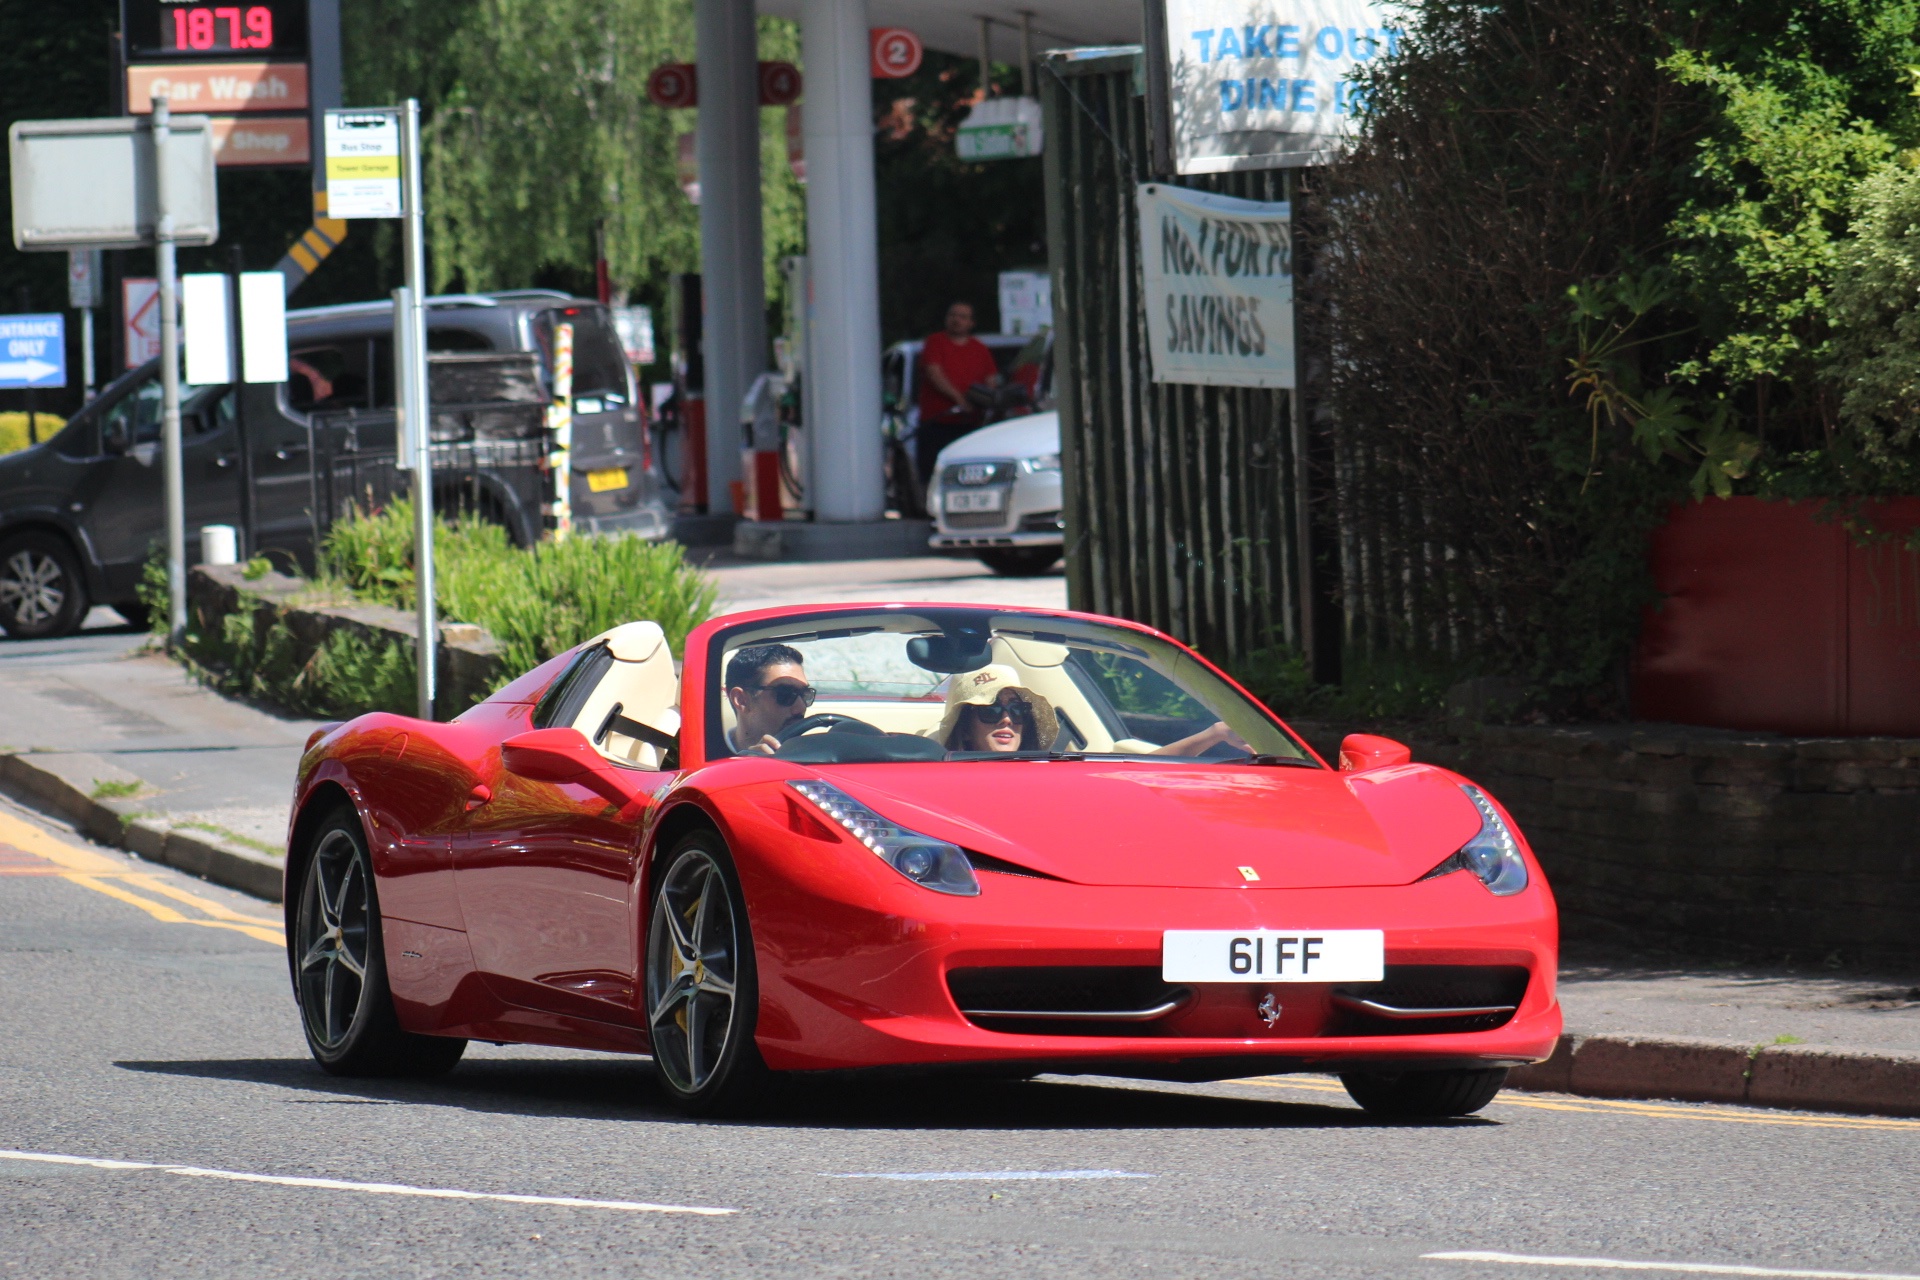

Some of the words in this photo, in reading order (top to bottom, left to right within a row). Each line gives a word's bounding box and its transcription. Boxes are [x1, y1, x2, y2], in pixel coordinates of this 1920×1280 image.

[173, 6, 273, 50] 187.9
[888, 41, 907, 64] 2
[1191, 25, 1301, 63] TAKE
[1315, 26, 1404, 61] OUT
[151, 78, 203, 100] Car
[208, 77, 289, 99] Wash
[660, 75, 679, 97] 3
[1219, 78, 1316, 113] DINE
[232, 132, 290, 153] Shop
[1211, 219, 1261, 278] FOR
[0, 321, 59, 338] NTRANCE
[1166, 293, 1266, 358] SAVINGS
[8, 339, 47, 358] ONLY
[1276, 937, 1324, 975] FF
